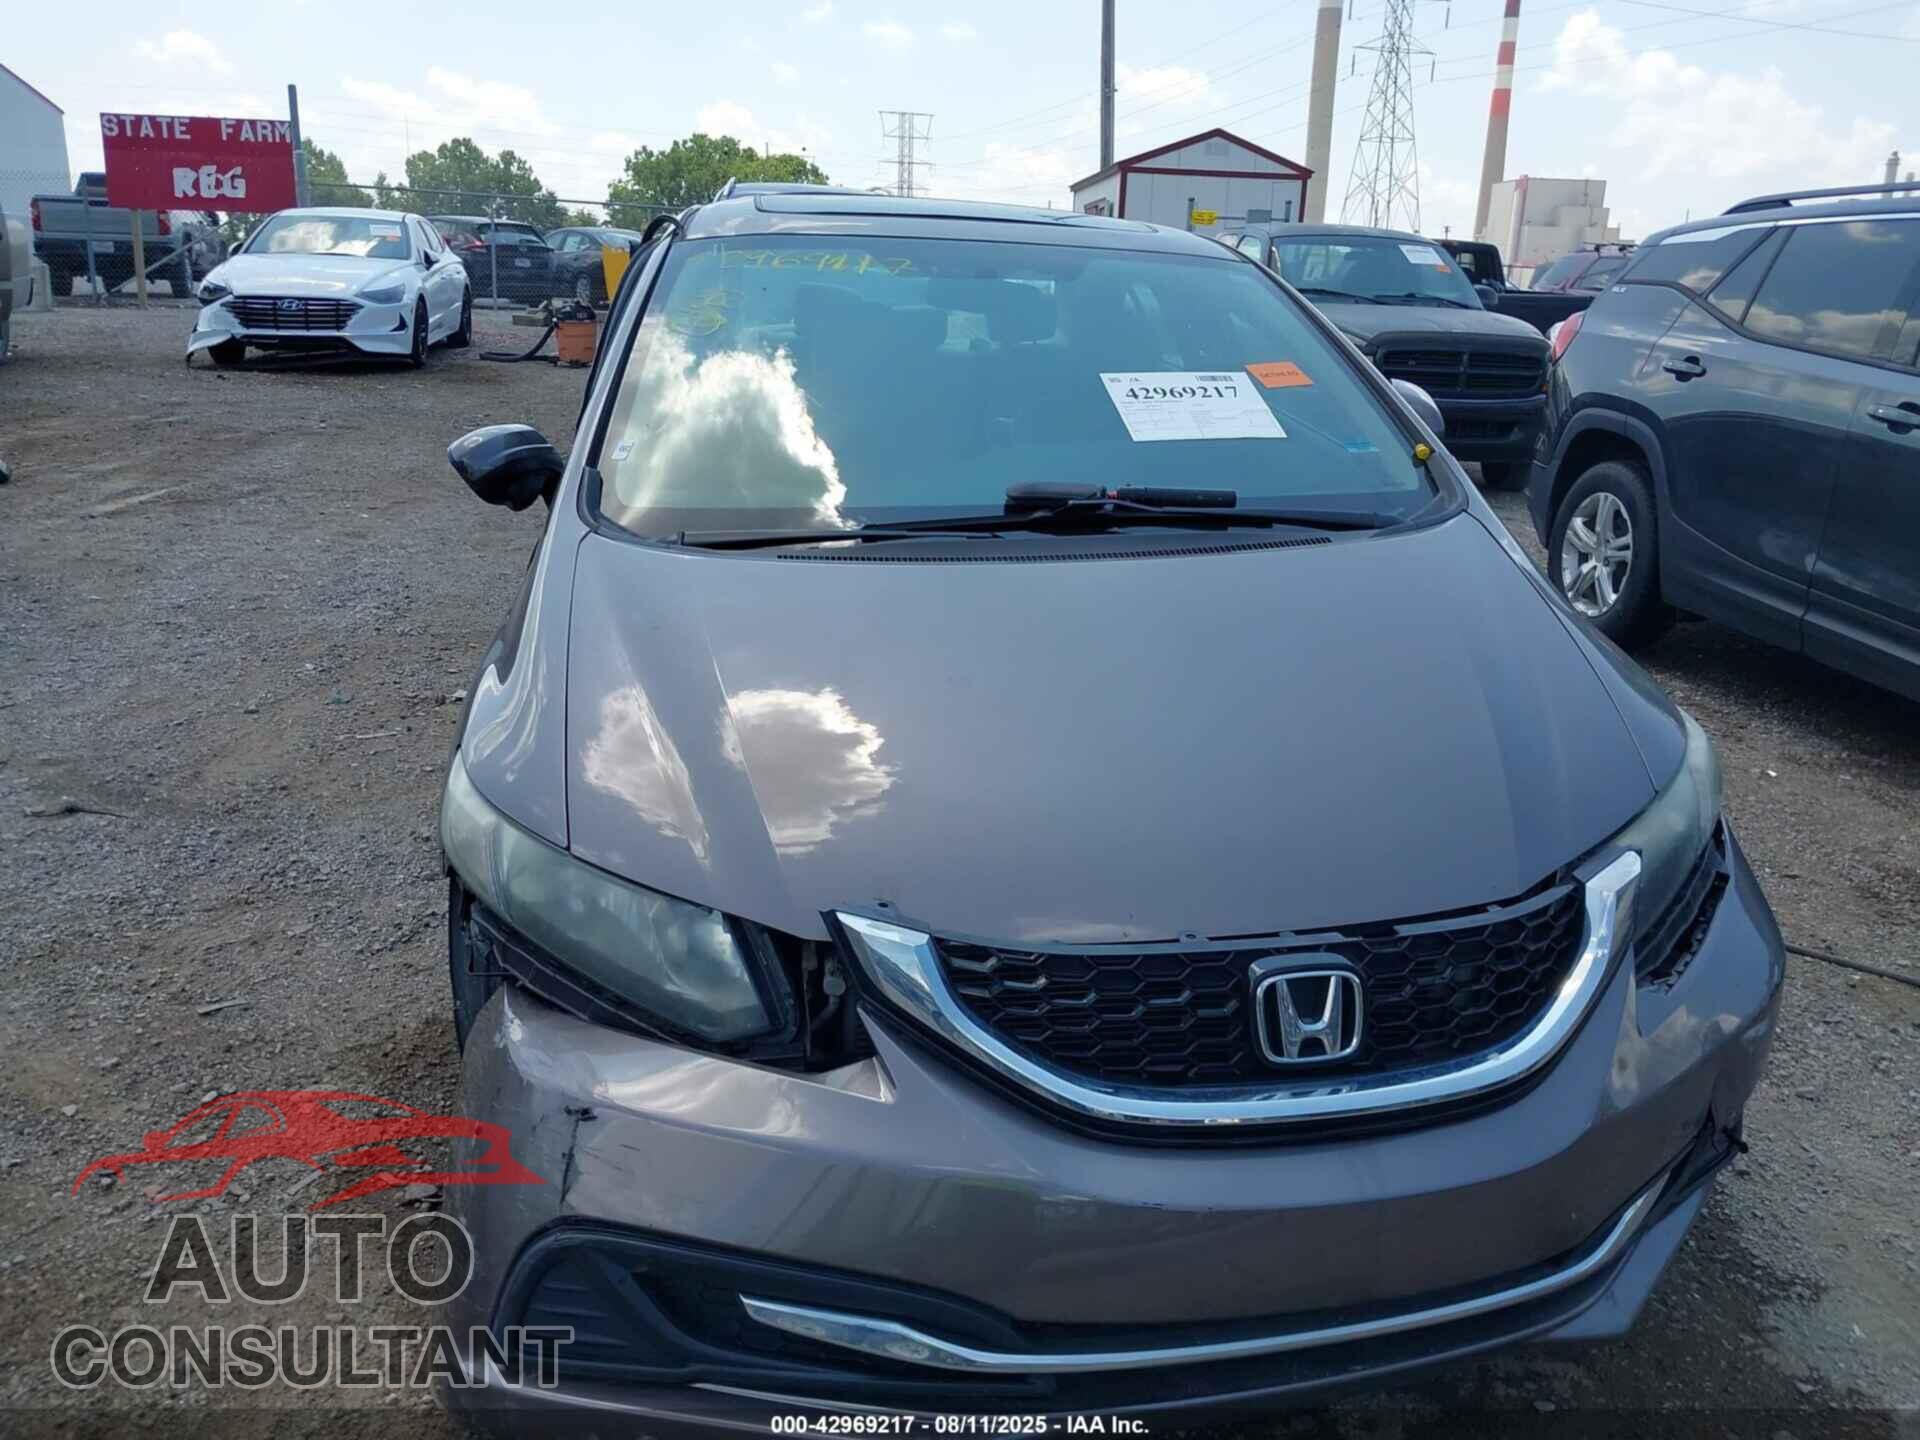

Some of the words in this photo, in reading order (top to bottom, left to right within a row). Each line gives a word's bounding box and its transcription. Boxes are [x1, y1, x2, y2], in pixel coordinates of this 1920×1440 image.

[103, 114, 191, 139] STATE
[221, 119, 291, 143] FARM
[1126, 386, 1237, 399] 42969217
